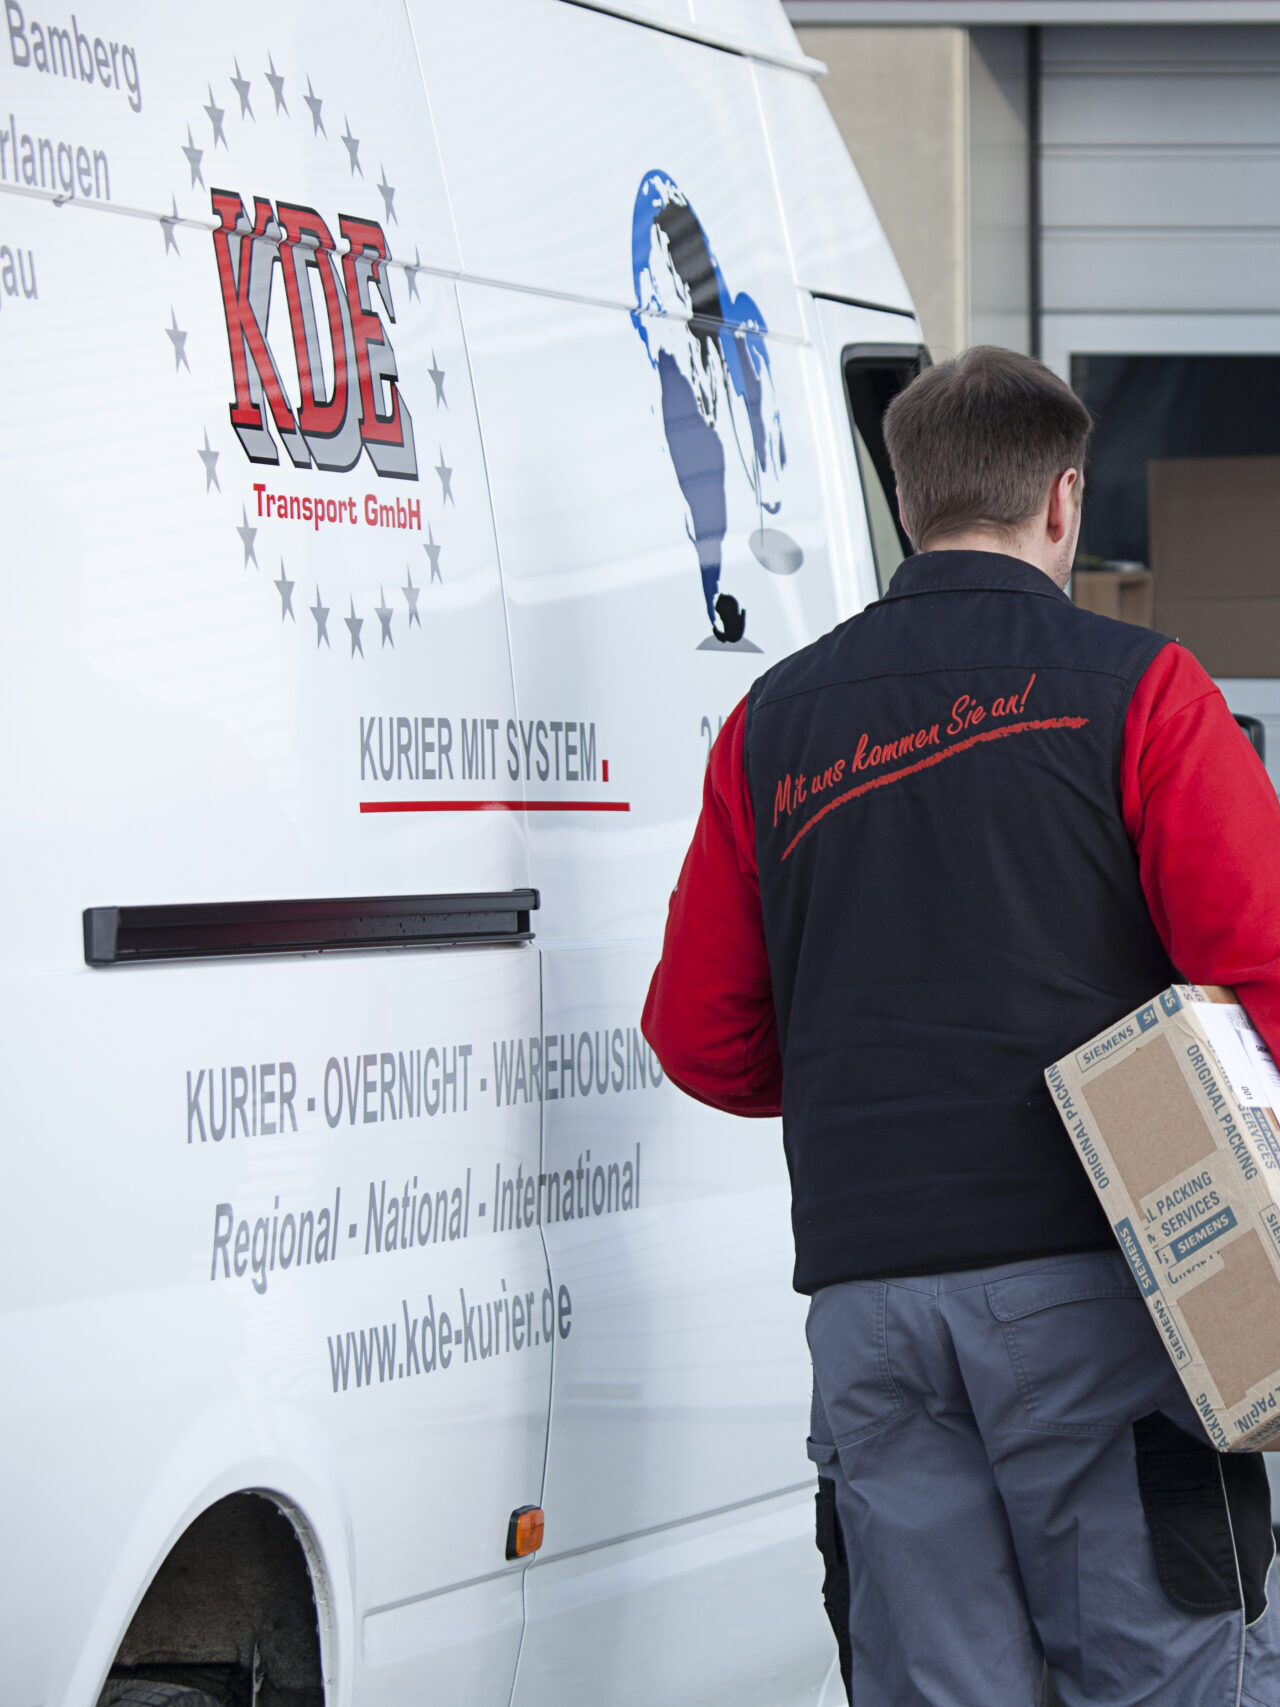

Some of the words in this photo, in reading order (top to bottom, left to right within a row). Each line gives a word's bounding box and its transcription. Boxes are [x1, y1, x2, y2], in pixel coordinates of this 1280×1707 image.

[5, 0, 142, 114] Bamberg
[0, 245, 39, 312] au
[210, 187, 419, 482] KDE
[253, 483, 357, 531] Transport
[364, 494, 422, 530] GmbH
[359, 716, 454, 782] KURIER
[461, 718, 499, 782] MIT
[506, 720, 609, 783] SYSTEM.
[773, 773, 808, 828] Mit
[811, 759, 846, 795] uns
[851, 733, 941, 774] kommen
[946, 694, 987, 735] Sie
[991, 673, 1037, 718] an!
[1082, 1024, 1135, 1065] SIEMENS
[186, 1061, 297, 1144] KURIER
[324, 1044, 473, 1130] OVERNIGHT
[1186, 1044, 1226, 1115] ORIGINAL
[1219, 1113, 1258, 1180] PACKING
[1073, 1118, 1110, 1190] ORIGINAL
[211, 1186, 341, 1295] Regional
[364, 1167, 472, 1256] National
[494, 1142, 642, 1233] International
[1156, 1171, 1213, 1216] PACKING
[1161, 1190, 1221, 1237] SERVICES
[1120, 1226, 1153, 1290] SIEMENS
[1177, 1213, 1230, 1254] SIEMENS
[327, 1278, 573, 1394] www.kde-kurier.de
[1153, 1299, 1186, 1361] SIEMENS
